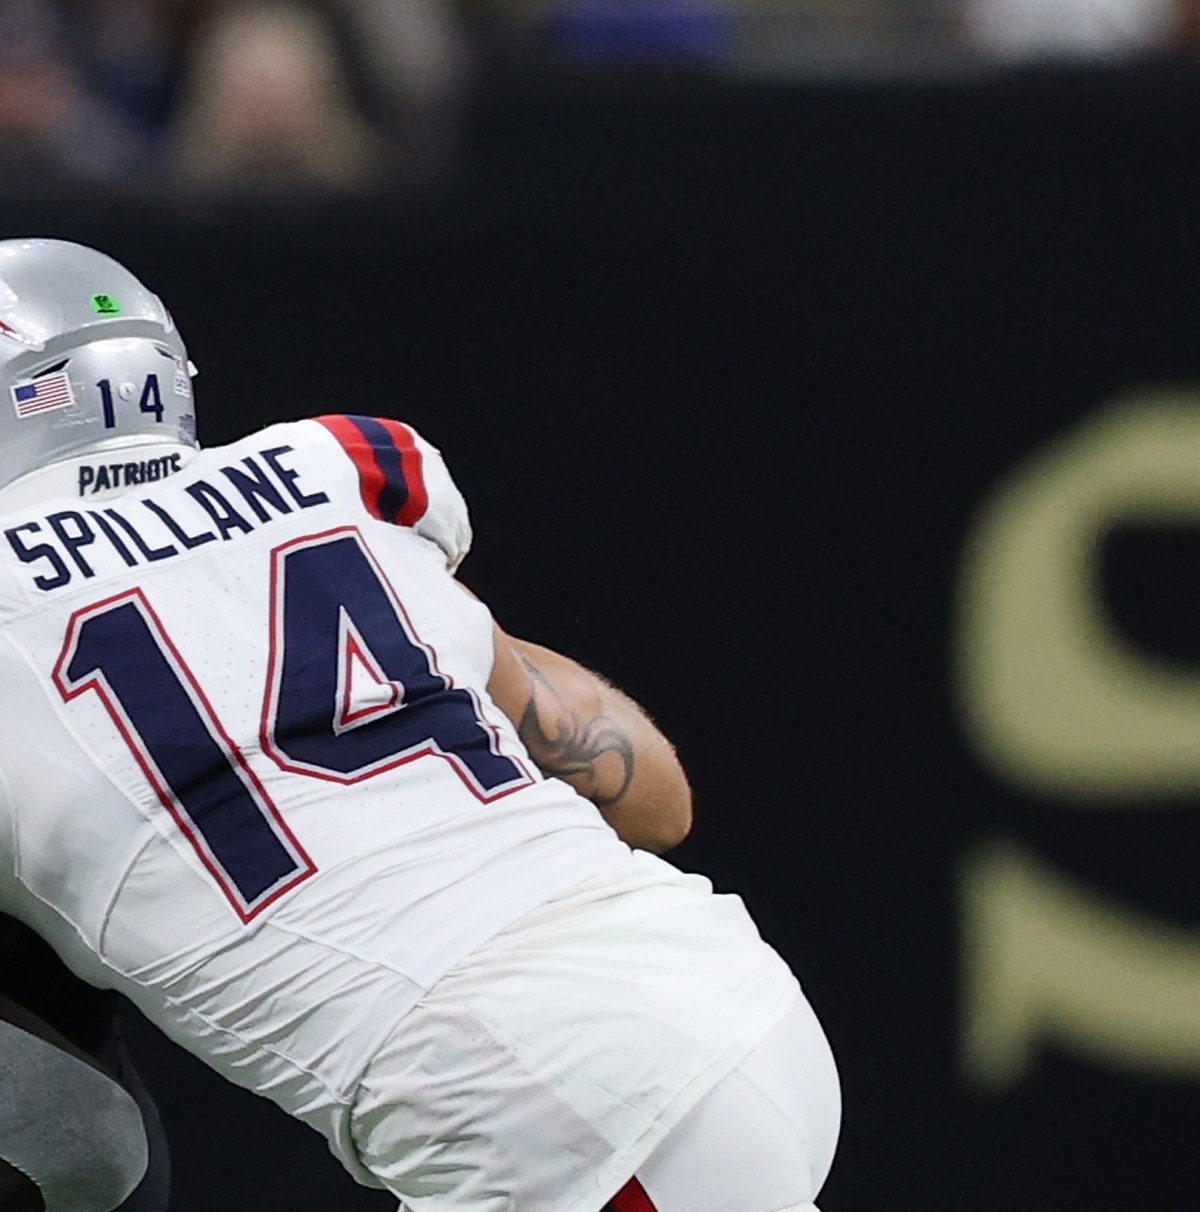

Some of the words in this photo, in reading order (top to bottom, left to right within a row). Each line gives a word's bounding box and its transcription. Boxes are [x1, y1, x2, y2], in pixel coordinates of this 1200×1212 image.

[96, 374, 164, 429] 14
[4, 445, 330, 591] SPILLANE
[52, 525, 536, 925] 14
